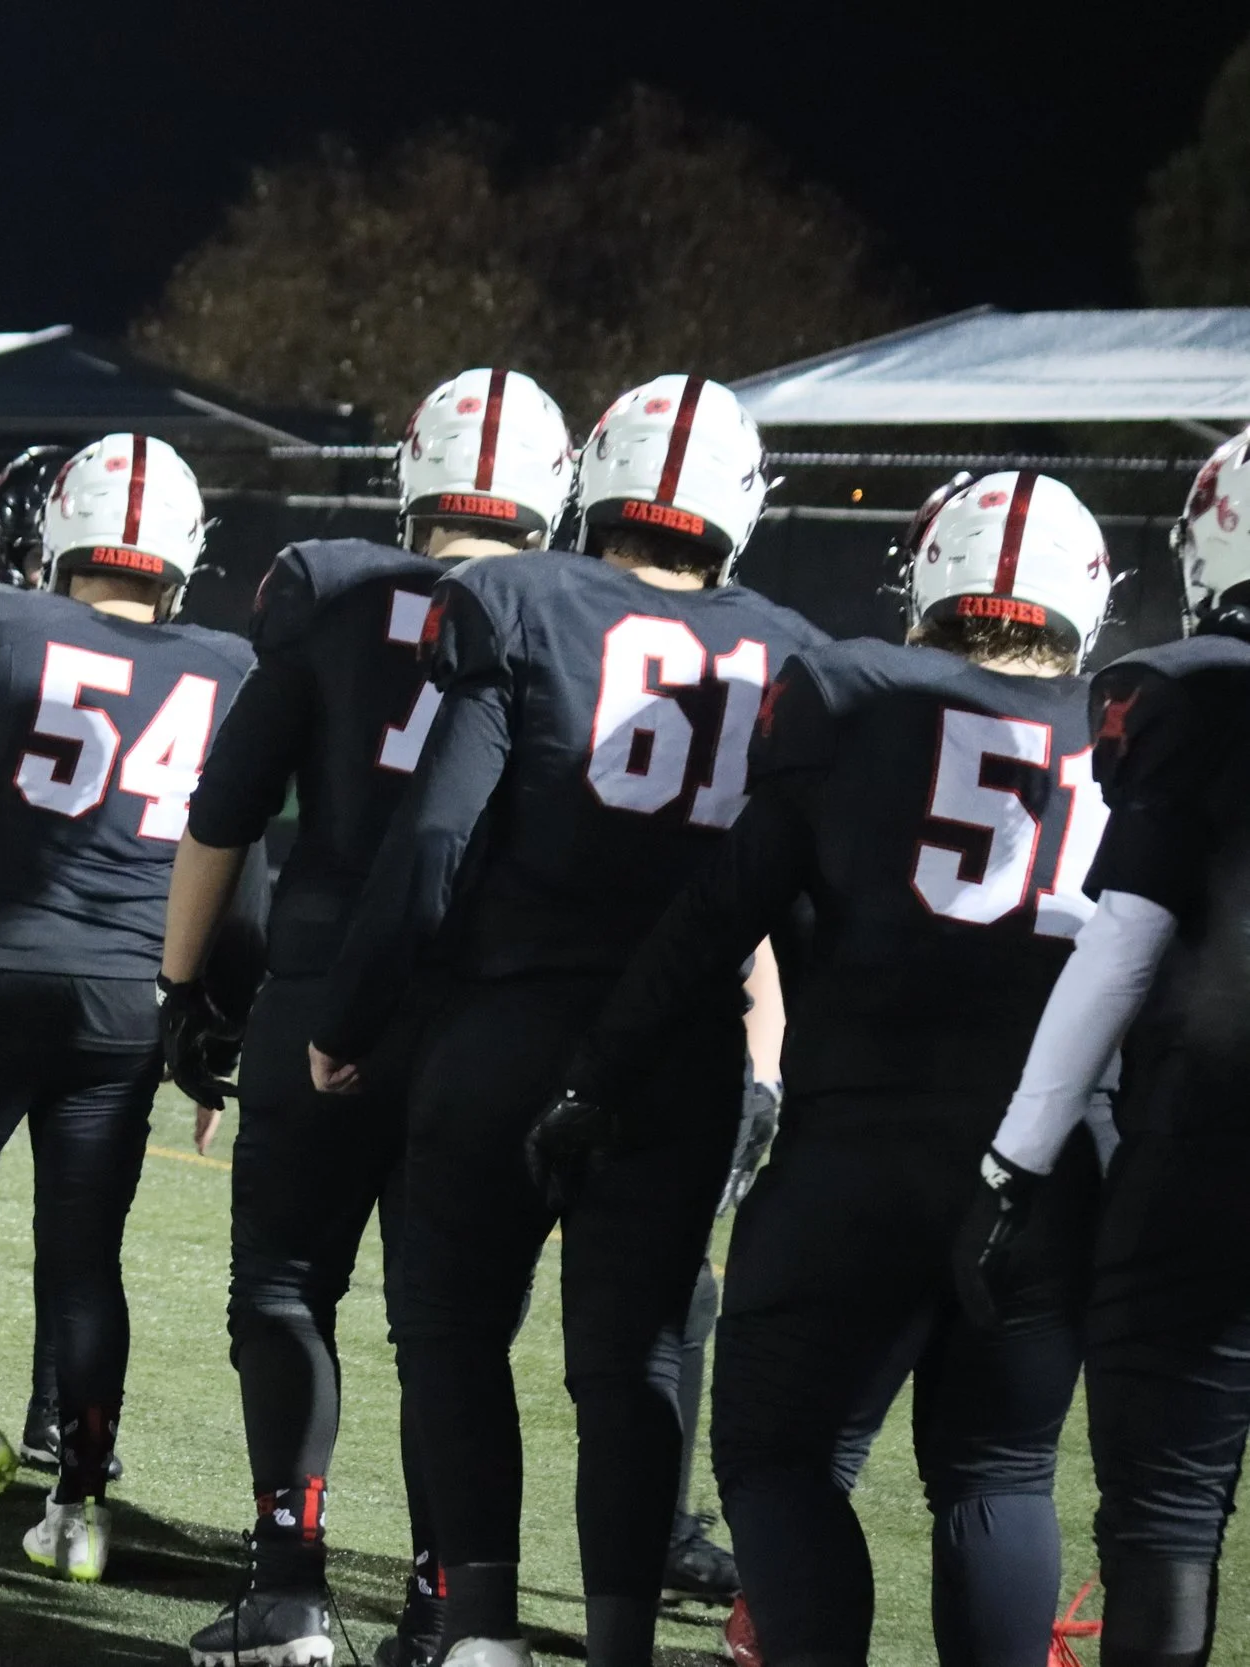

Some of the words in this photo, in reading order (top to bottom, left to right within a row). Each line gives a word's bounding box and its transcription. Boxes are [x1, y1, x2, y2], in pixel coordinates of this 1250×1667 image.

[91, 546, 165, 575] SABRES
[621, 500, 705, 536] SABRES
[957, 596, 1047, 626] SABRES
[13, 640, 218, 842] 54
[584, 612, 768, 831] 61
[911, 706, 1112, 940] 51
